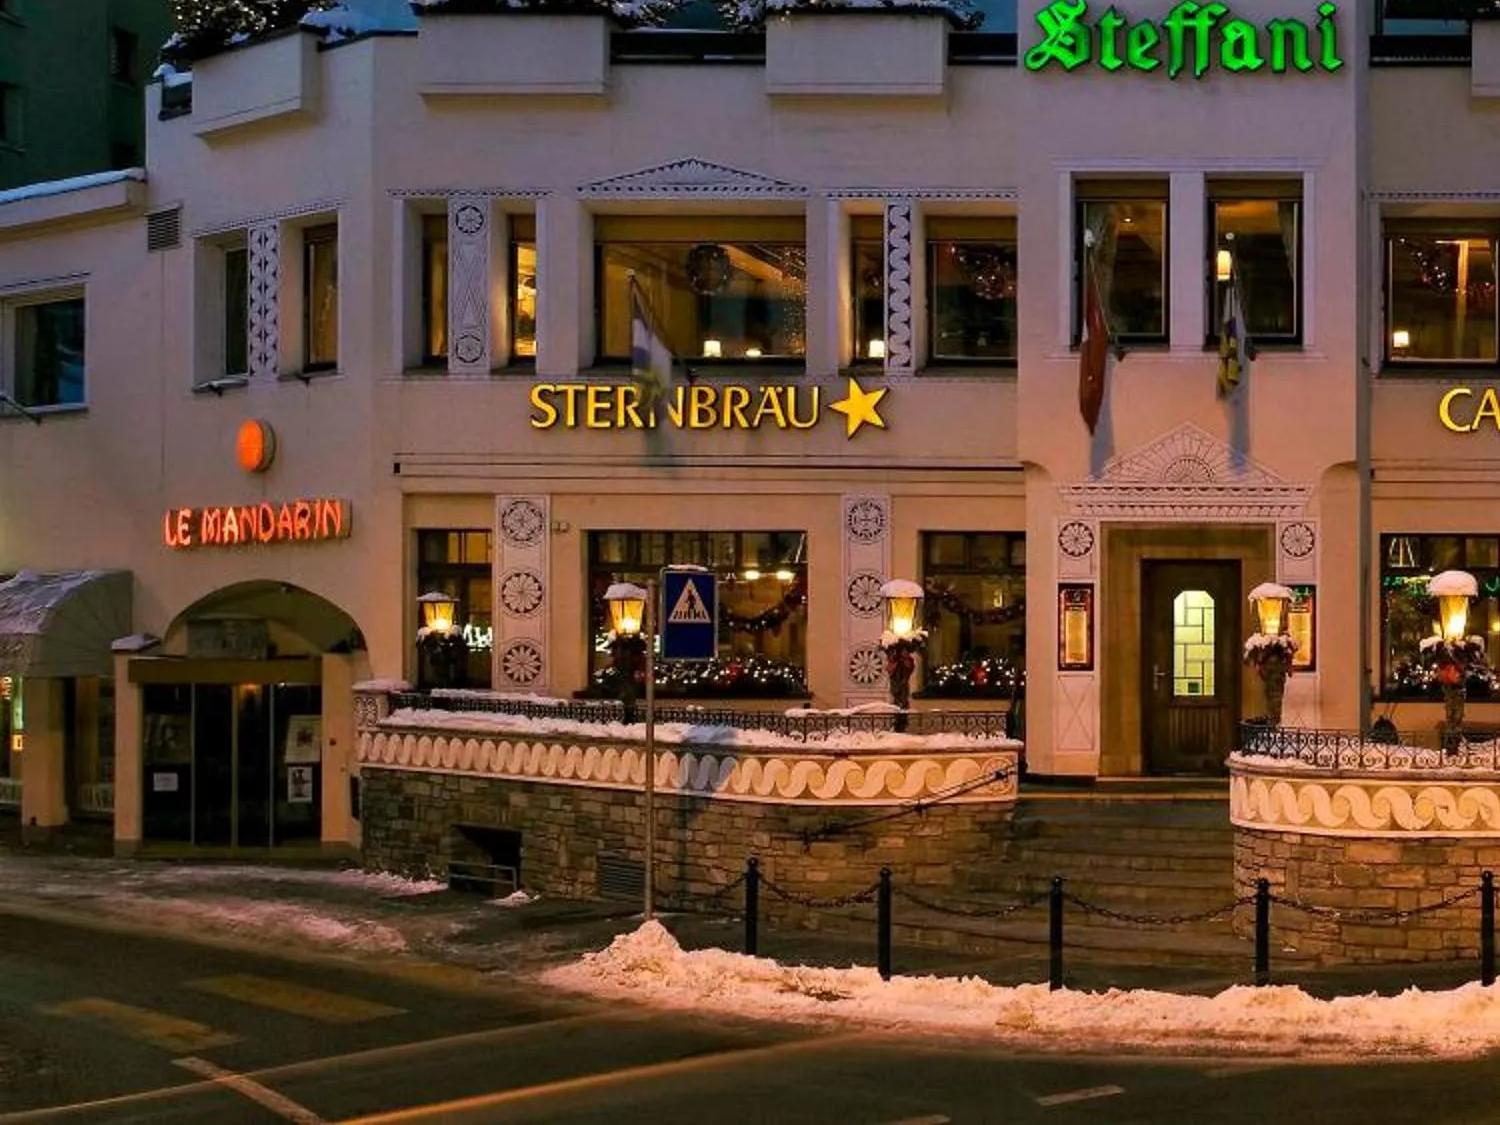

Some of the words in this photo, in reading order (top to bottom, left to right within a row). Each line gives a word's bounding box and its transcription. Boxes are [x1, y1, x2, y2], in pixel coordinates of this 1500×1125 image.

[529, 383, 821, 430] STERNBRÄU
[163, 507, 193, 547] LE
[200, 498, 343, 545] MANDARIN
